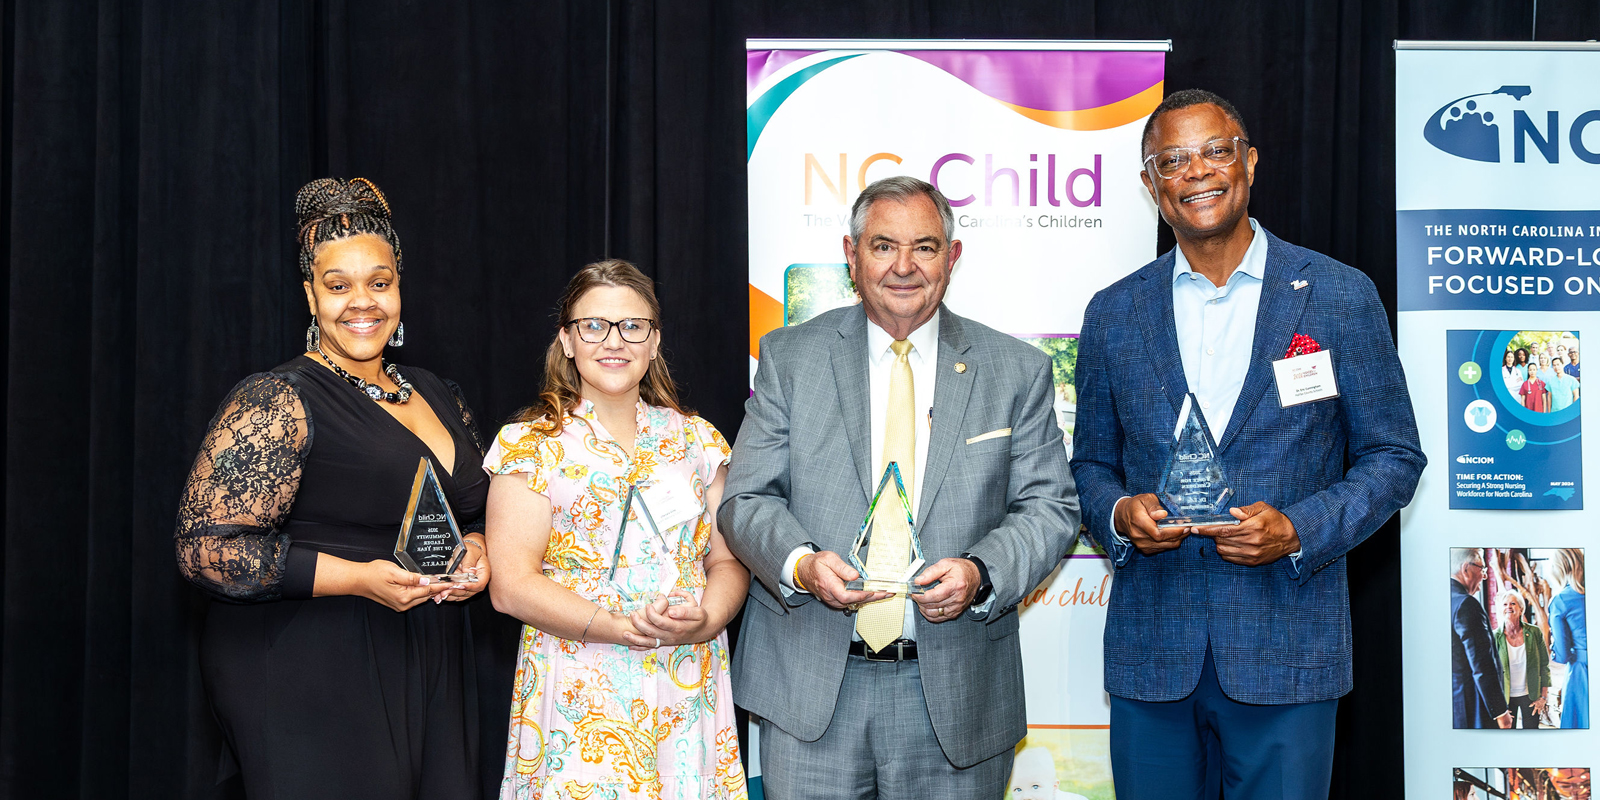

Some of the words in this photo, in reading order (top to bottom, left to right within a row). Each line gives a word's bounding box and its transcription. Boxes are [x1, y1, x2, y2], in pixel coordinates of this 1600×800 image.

[929, 152, 1102, 208] Child
[804, 214, 833, 227] The
[958, 214, 1033, 228] Carolina's
[1038, 214, 1103, 228] Children
[1424, 225, 1452, 236] THE
[1458, 225, 1507, 236] NORTH
[1512, 225, 1584, 237] CAROLINA
[1428, 275, 1554, 295] FOCUSED
[1564, 276, 1600, 296] ON
[1456, 482, 1481, 490] Securing
[1486, 482, 1504, 490] Strong
[1504, 482, 1526, 490] Nursing
[1510, 490, 1533, 498] Carolina
[1058, 574, 1110, 607] chil
